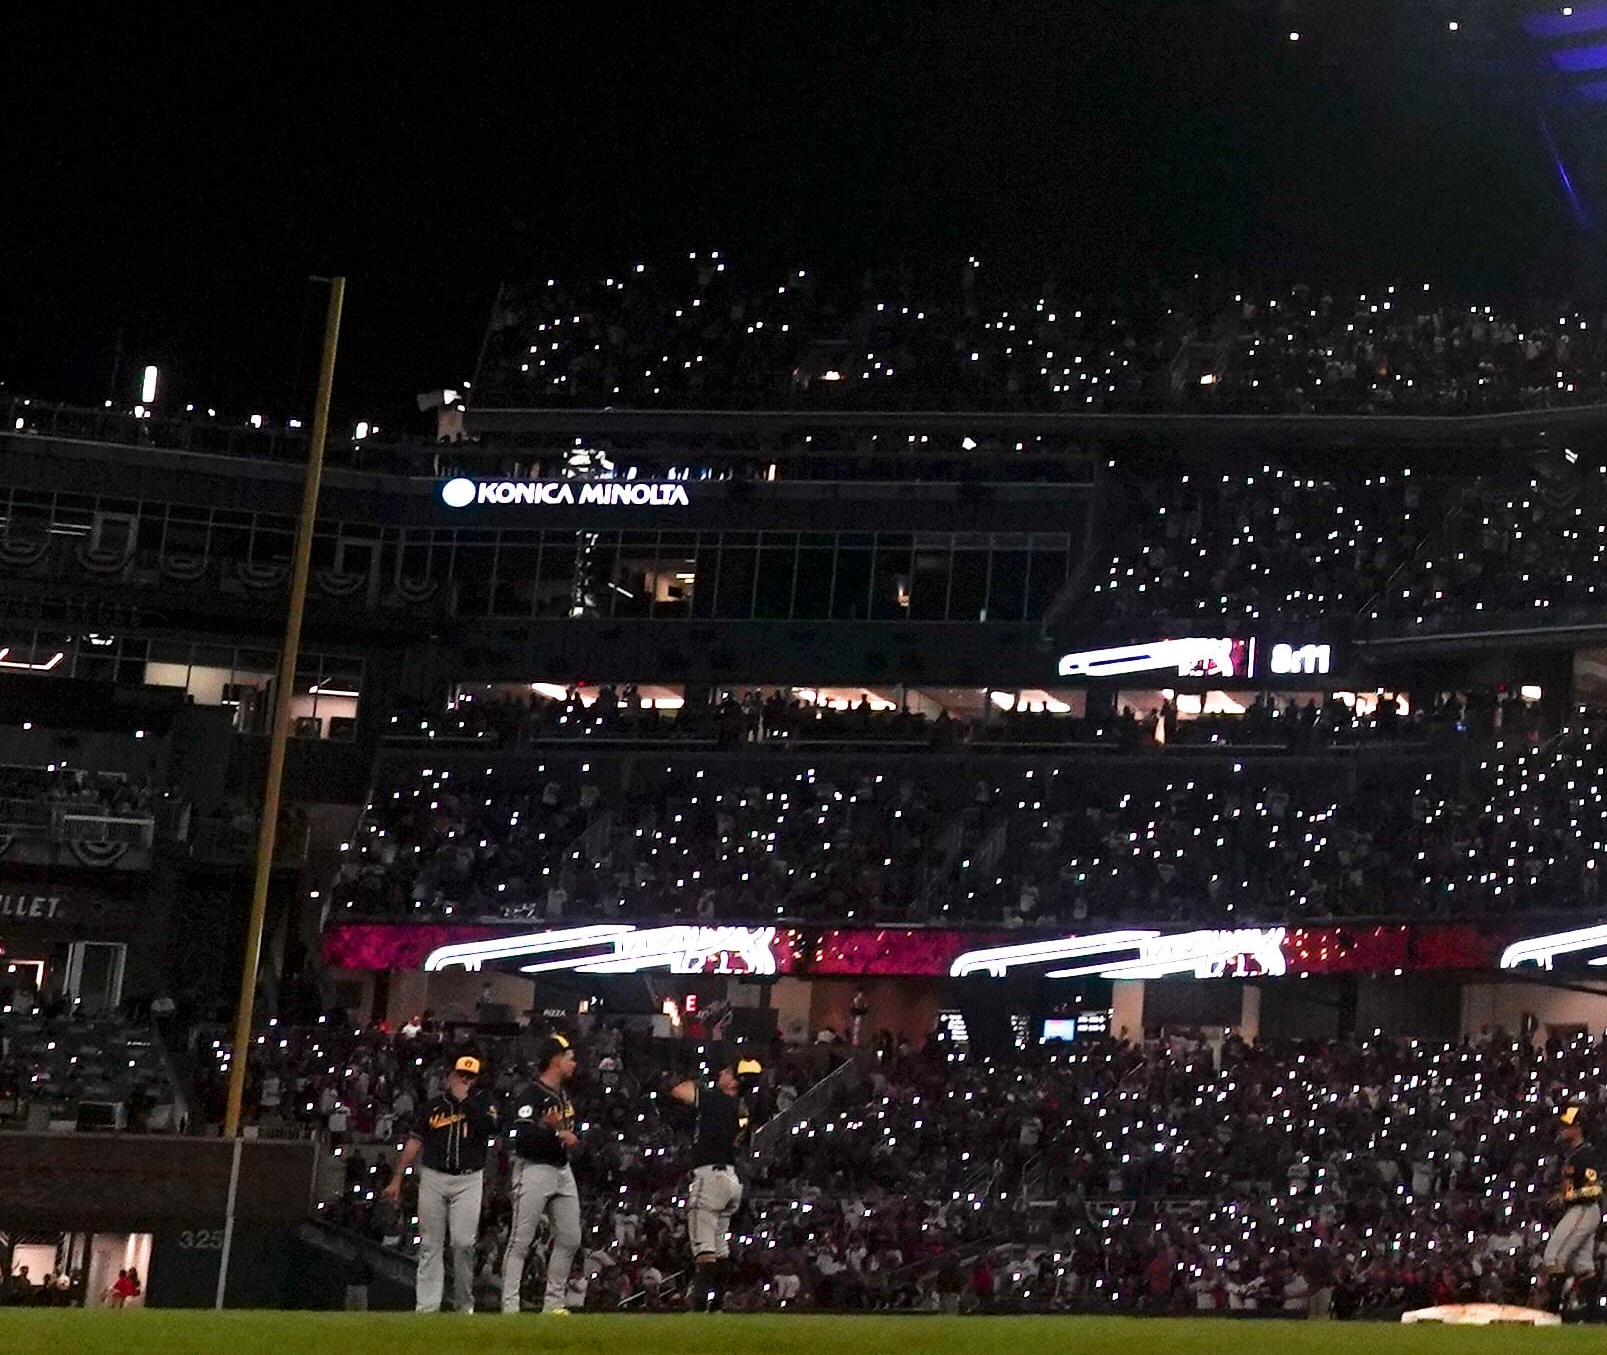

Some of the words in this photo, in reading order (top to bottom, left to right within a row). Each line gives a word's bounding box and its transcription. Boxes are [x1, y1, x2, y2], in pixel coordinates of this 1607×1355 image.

[477, 482, 575, 505] KONICA
[578, 483, 689, 505] MINOLTA
[1271, 643, 1331, 673] 8:11
[179, 1230, 224, 1249] 325
